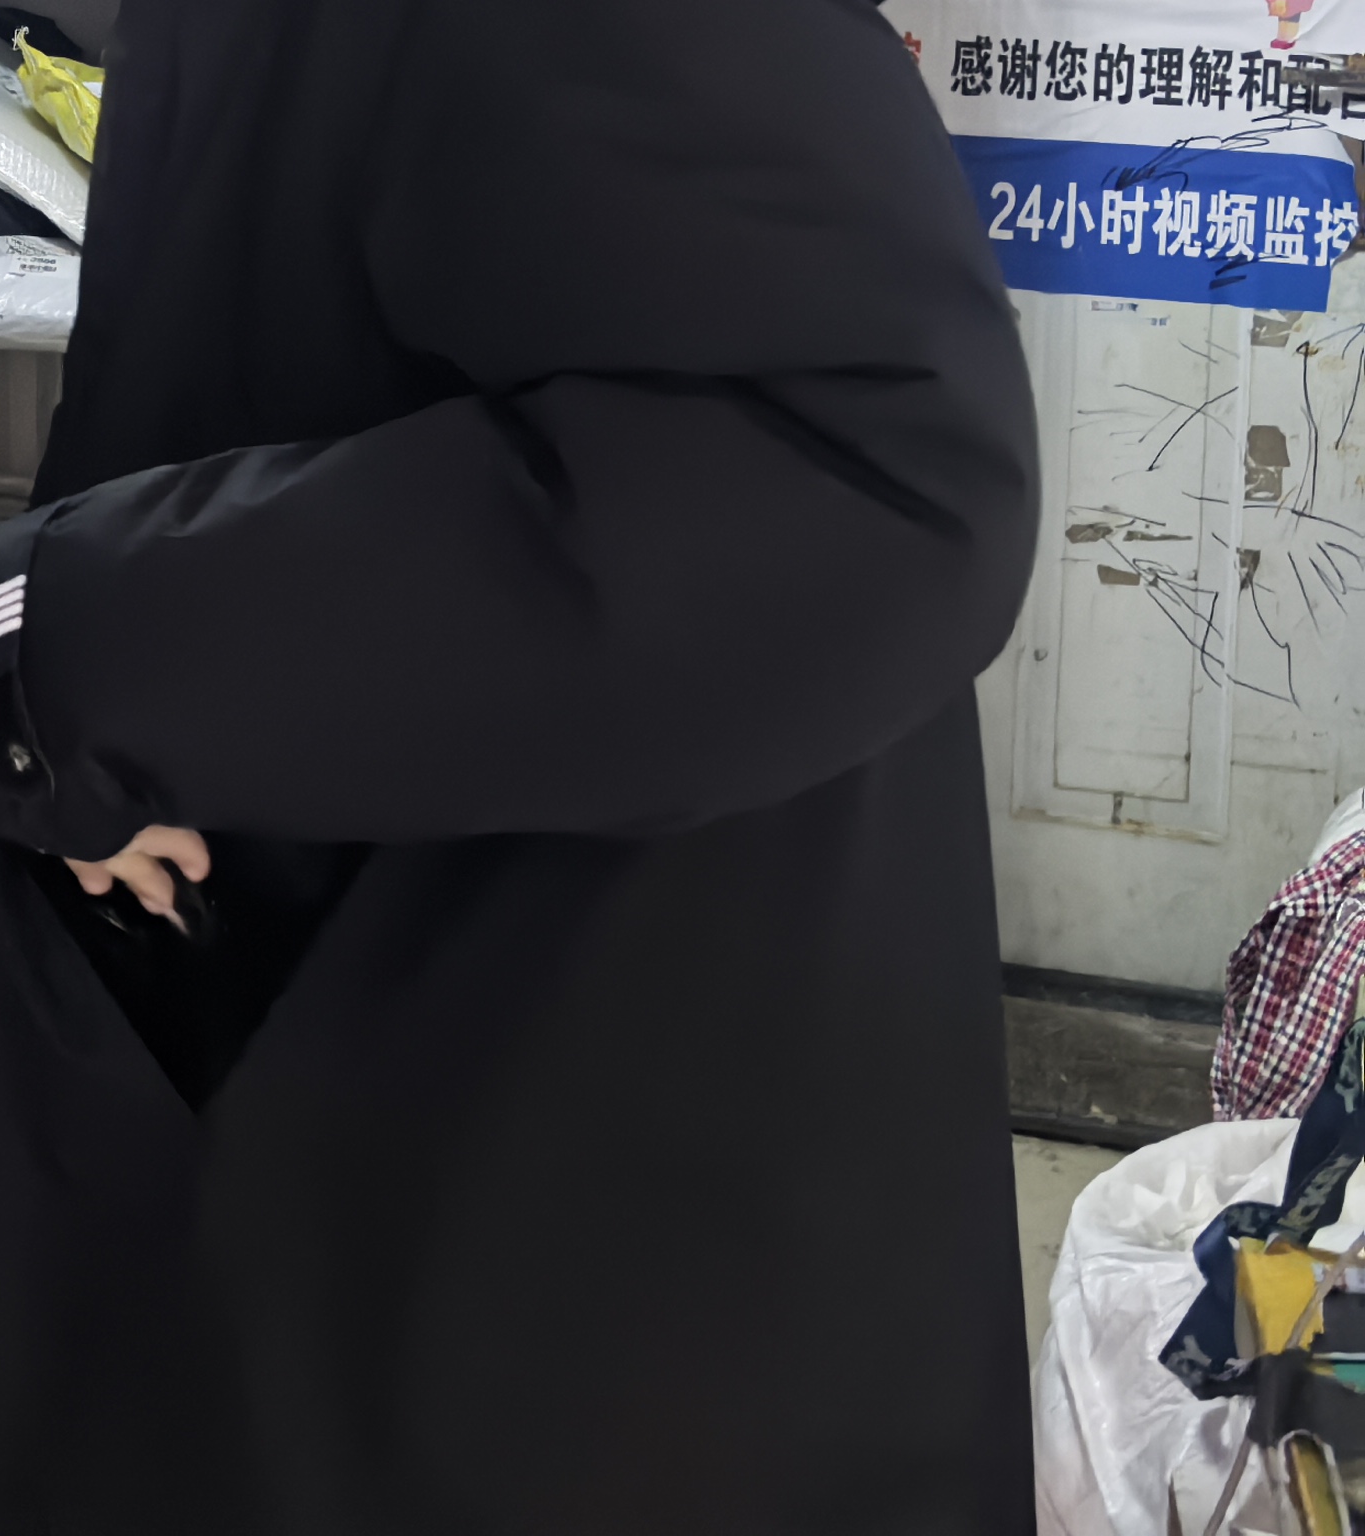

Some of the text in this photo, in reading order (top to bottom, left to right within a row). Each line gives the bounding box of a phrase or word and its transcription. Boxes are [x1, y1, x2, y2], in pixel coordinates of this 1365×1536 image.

[988, 181, 1358, 267] 24小时视频监控
